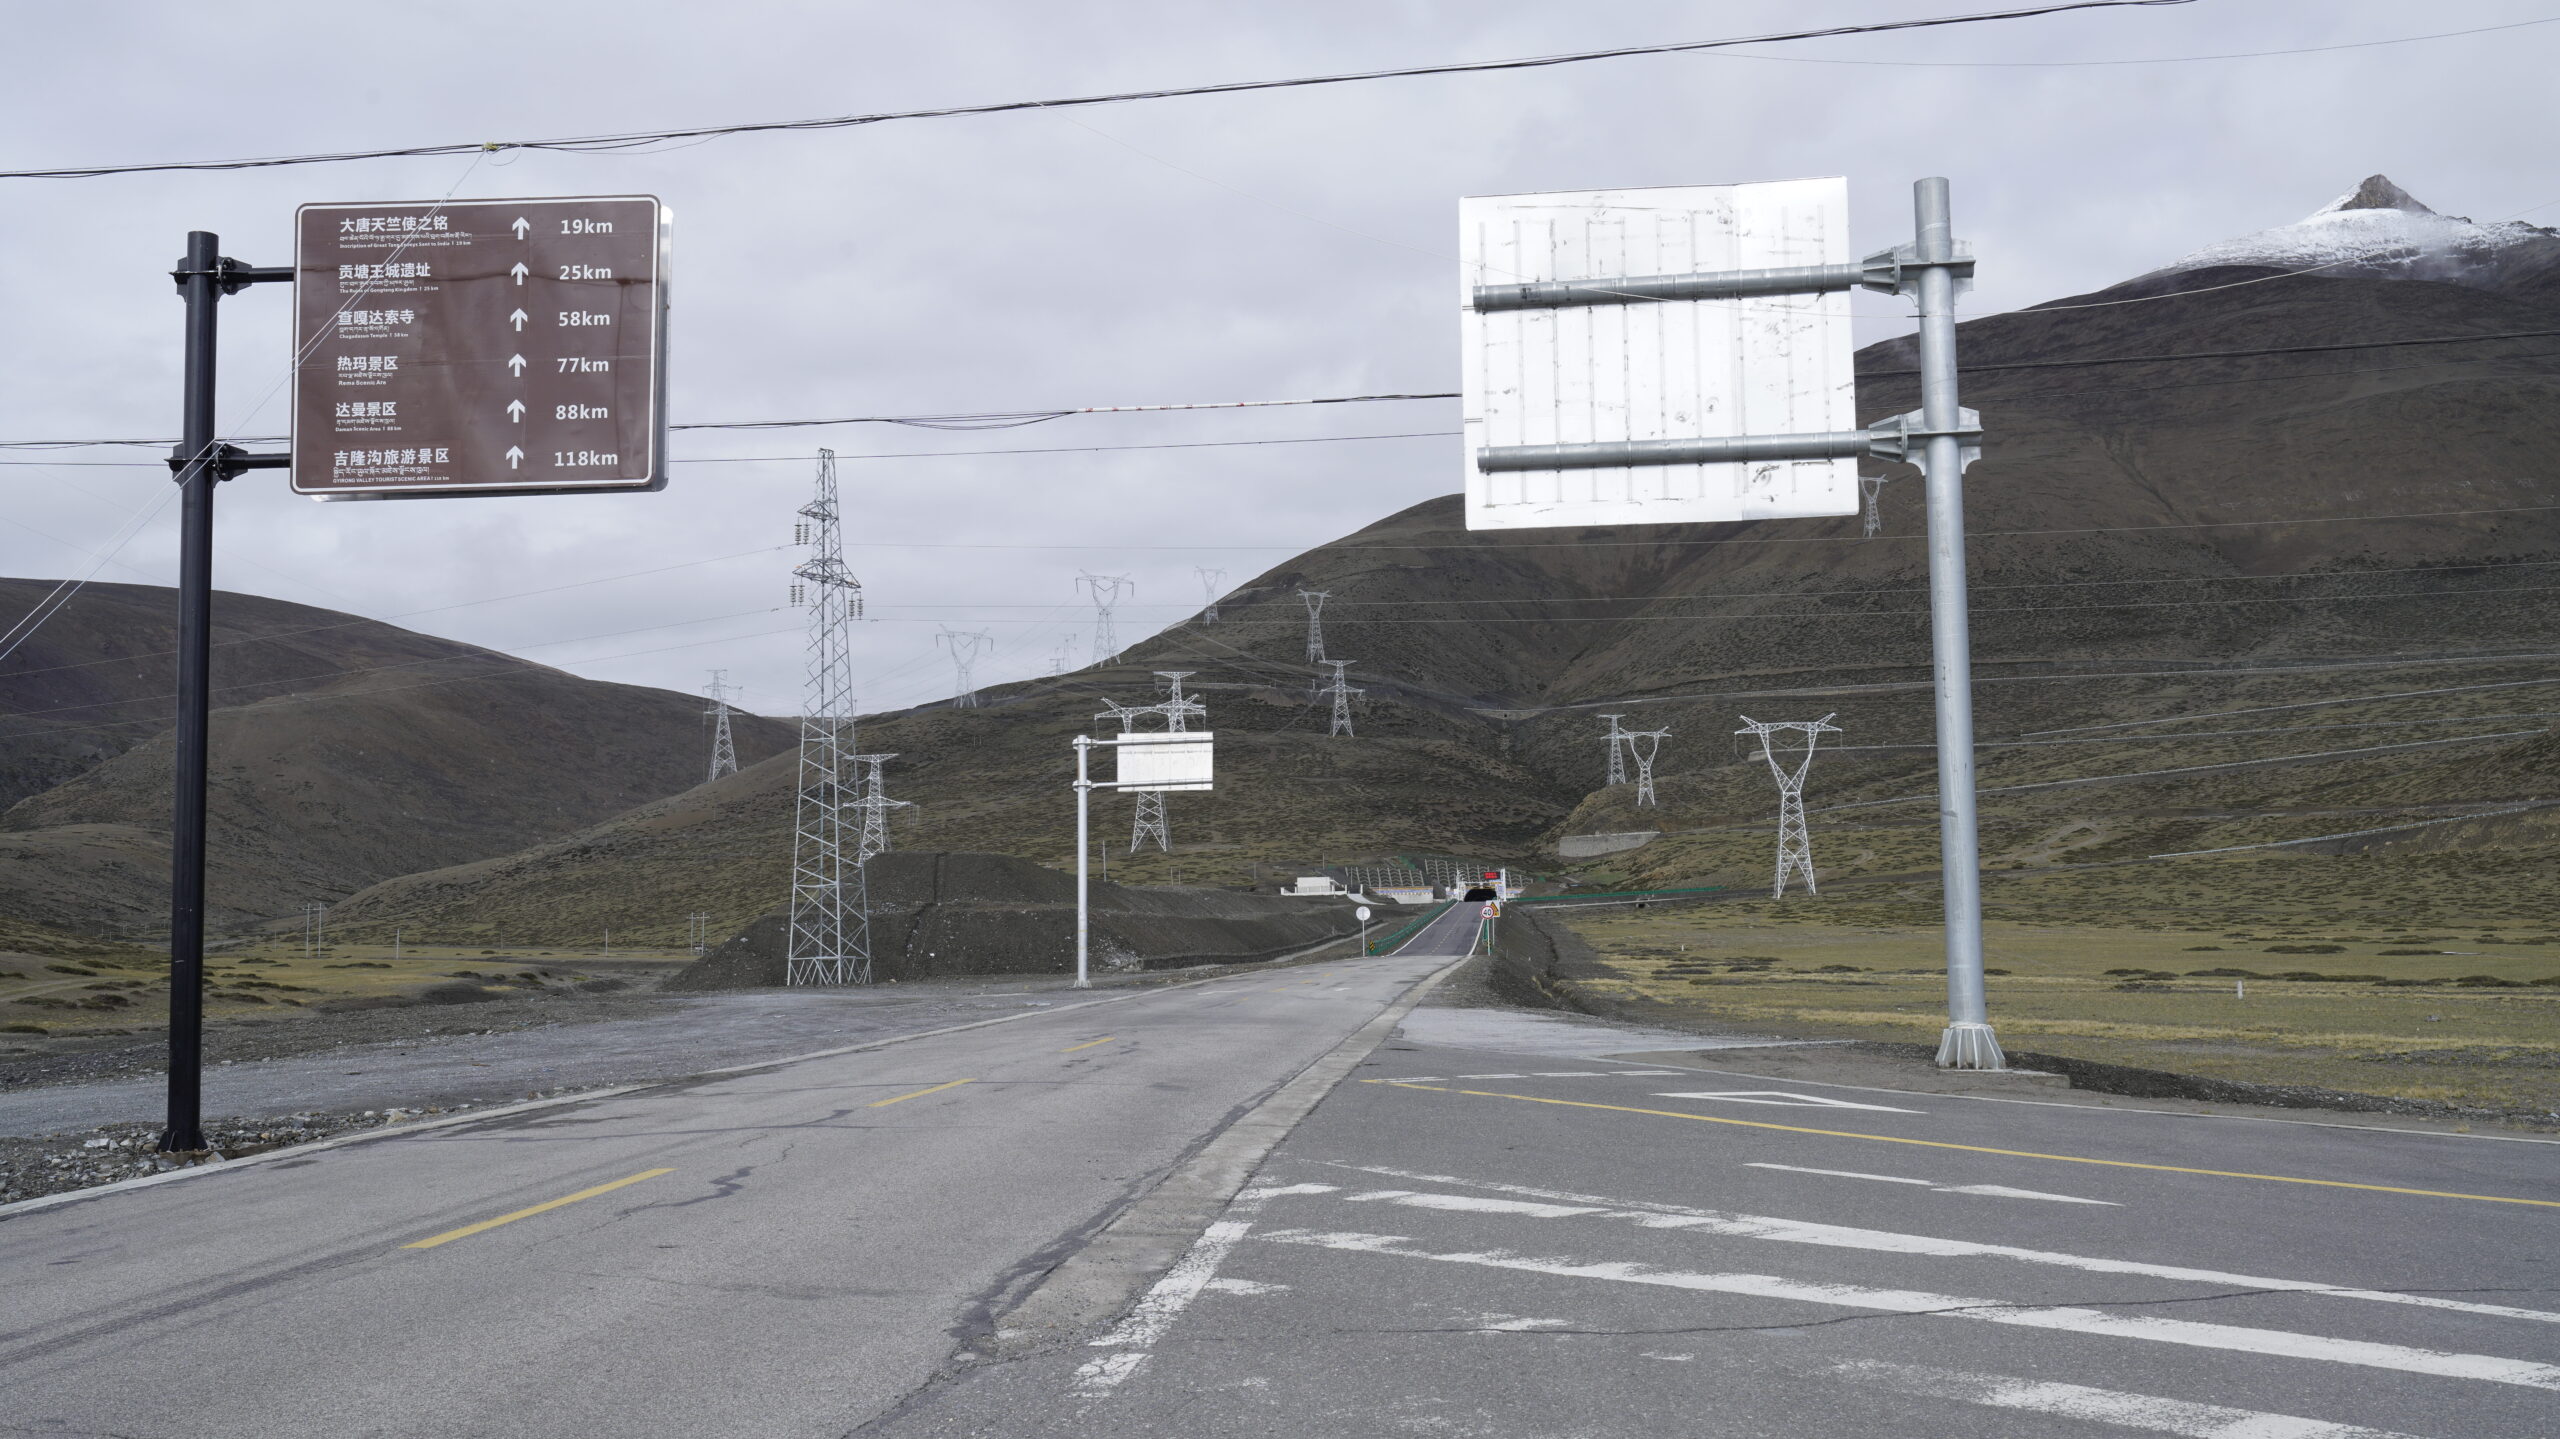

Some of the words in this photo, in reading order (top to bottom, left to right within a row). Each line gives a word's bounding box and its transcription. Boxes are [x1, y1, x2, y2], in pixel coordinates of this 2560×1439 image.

[340, 215, 448, 233] 大唐天竺使之铭
[560, 218, 613, 234] 19km
[339, 262, 431, 279] 贡塘王城遗址
[559, 264, 612, 280] 25km
[338, 309, 415, 326] 查嘎达索寺
[558, 311, 610, 327] 58km
[337, 356, 398, 371] 热玛景区
[557, 357, 609, 373] 77km
[335, 402, 396, 417] 达曼景区
[555, 404, 608, 420] 88km
[334, 448, 449, 466] 吉隆沟旅游景区
[554, 450, 618, 467] 118km
[1483, 908, 1491, 916] 40
